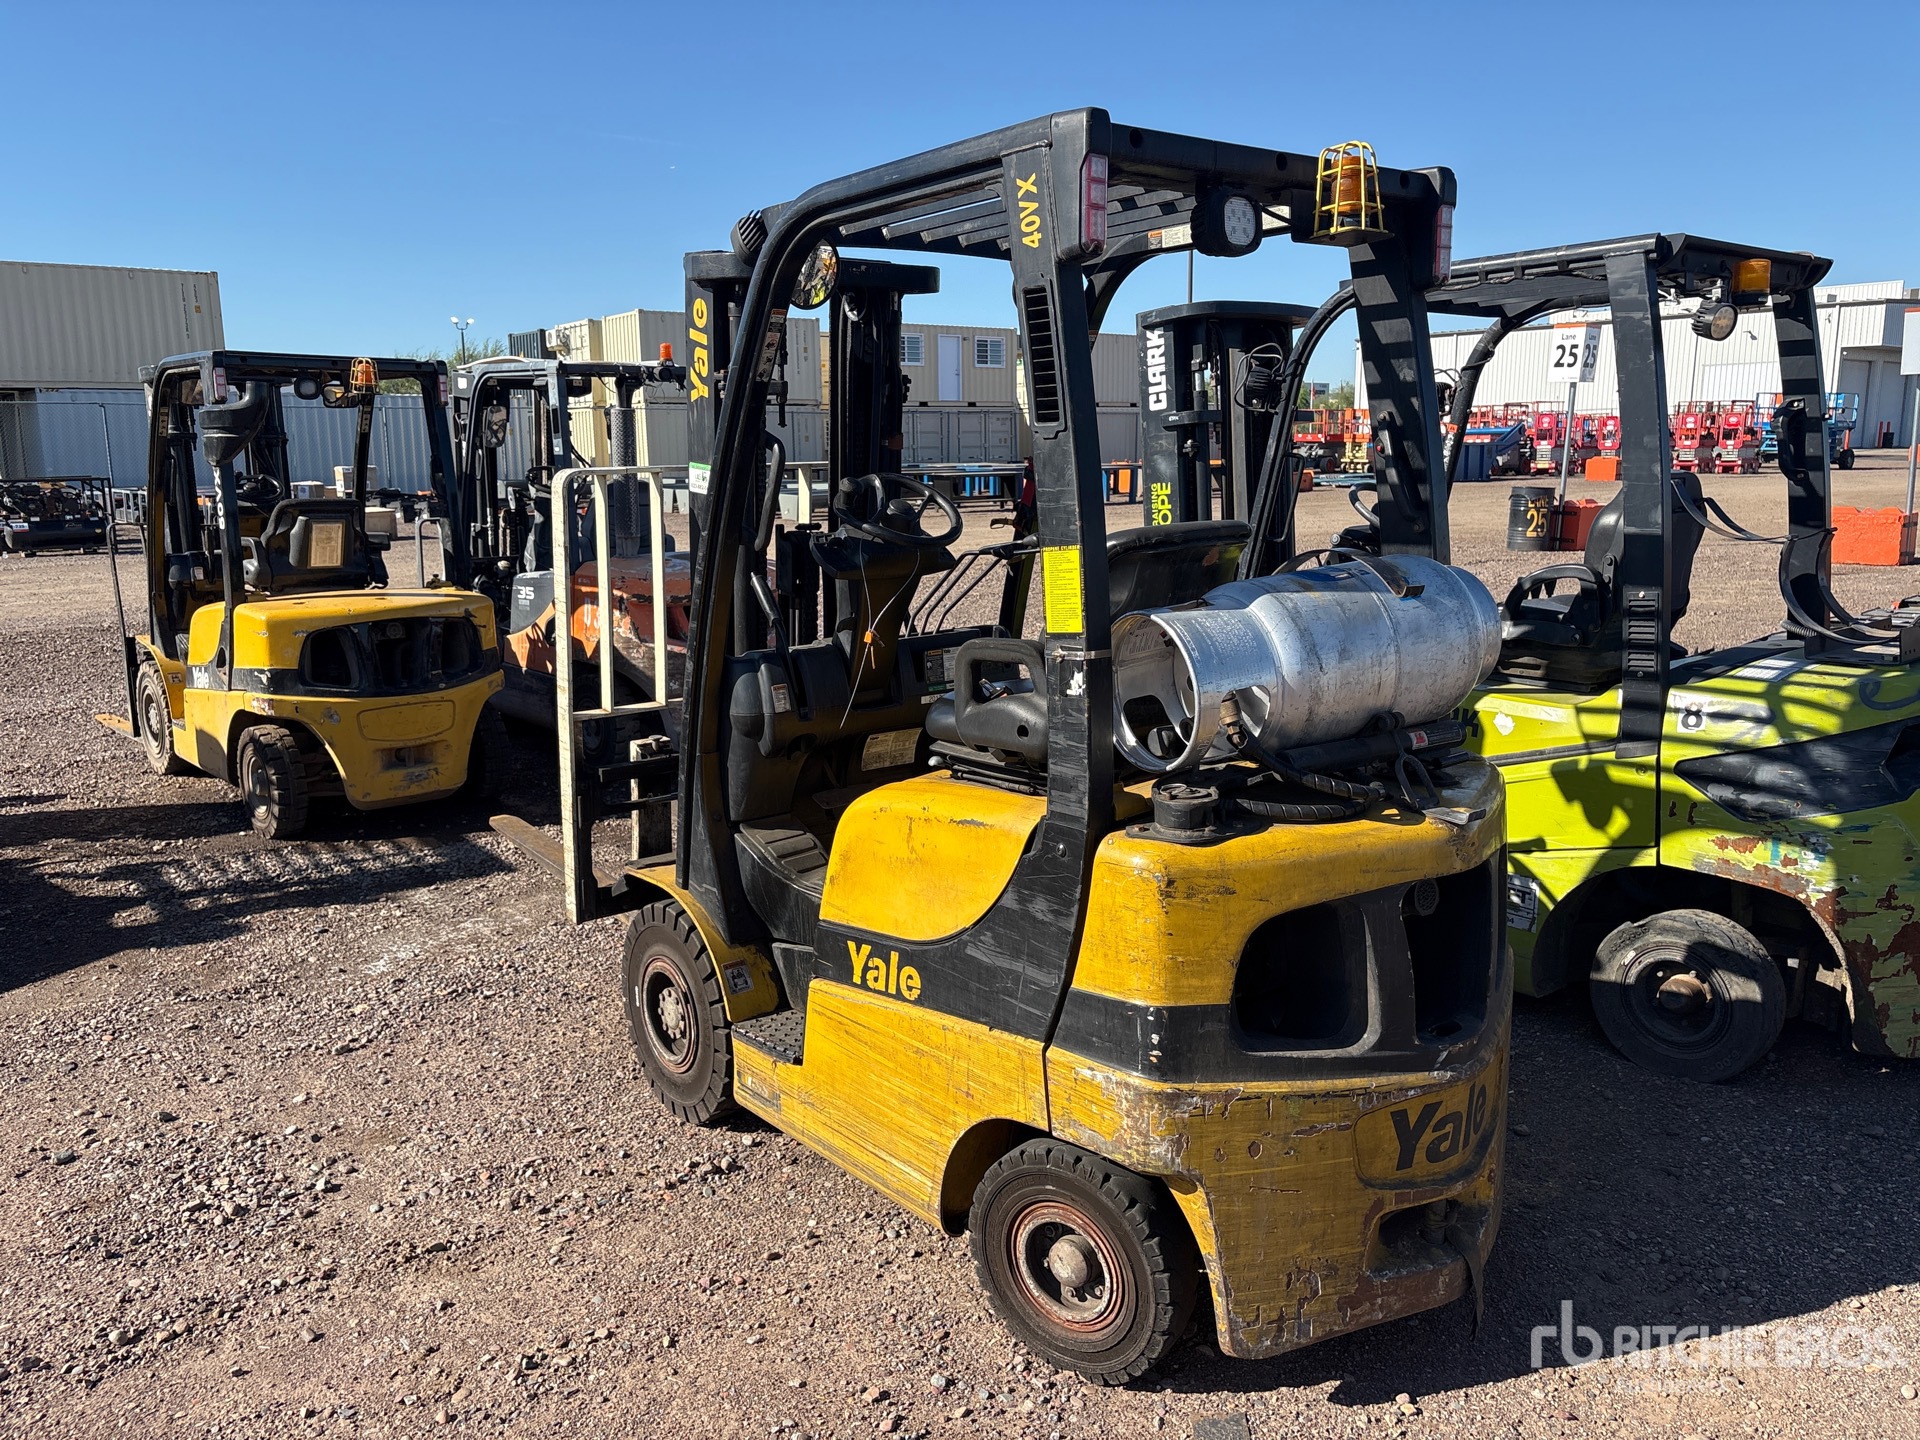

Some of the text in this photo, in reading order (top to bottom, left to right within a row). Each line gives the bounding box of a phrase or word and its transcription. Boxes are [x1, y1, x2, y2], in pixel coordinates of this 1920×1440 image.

[689, 297, 709, 402] Yale
[1561, 333, 1577, 341] Lane
[1146, 327, 1167, 411] CLARK
[1553, 344, 1579, 368] 25
[1582, 343, 1598, 369] 25
[1526, 508, 1548, 537] 25
[517, 587, 535, 599] 35
[192, 666, 210, 689] Yale
[846, 940, 922, 1001] Yale
[1390, 1080, 1487, 1172] Yale
